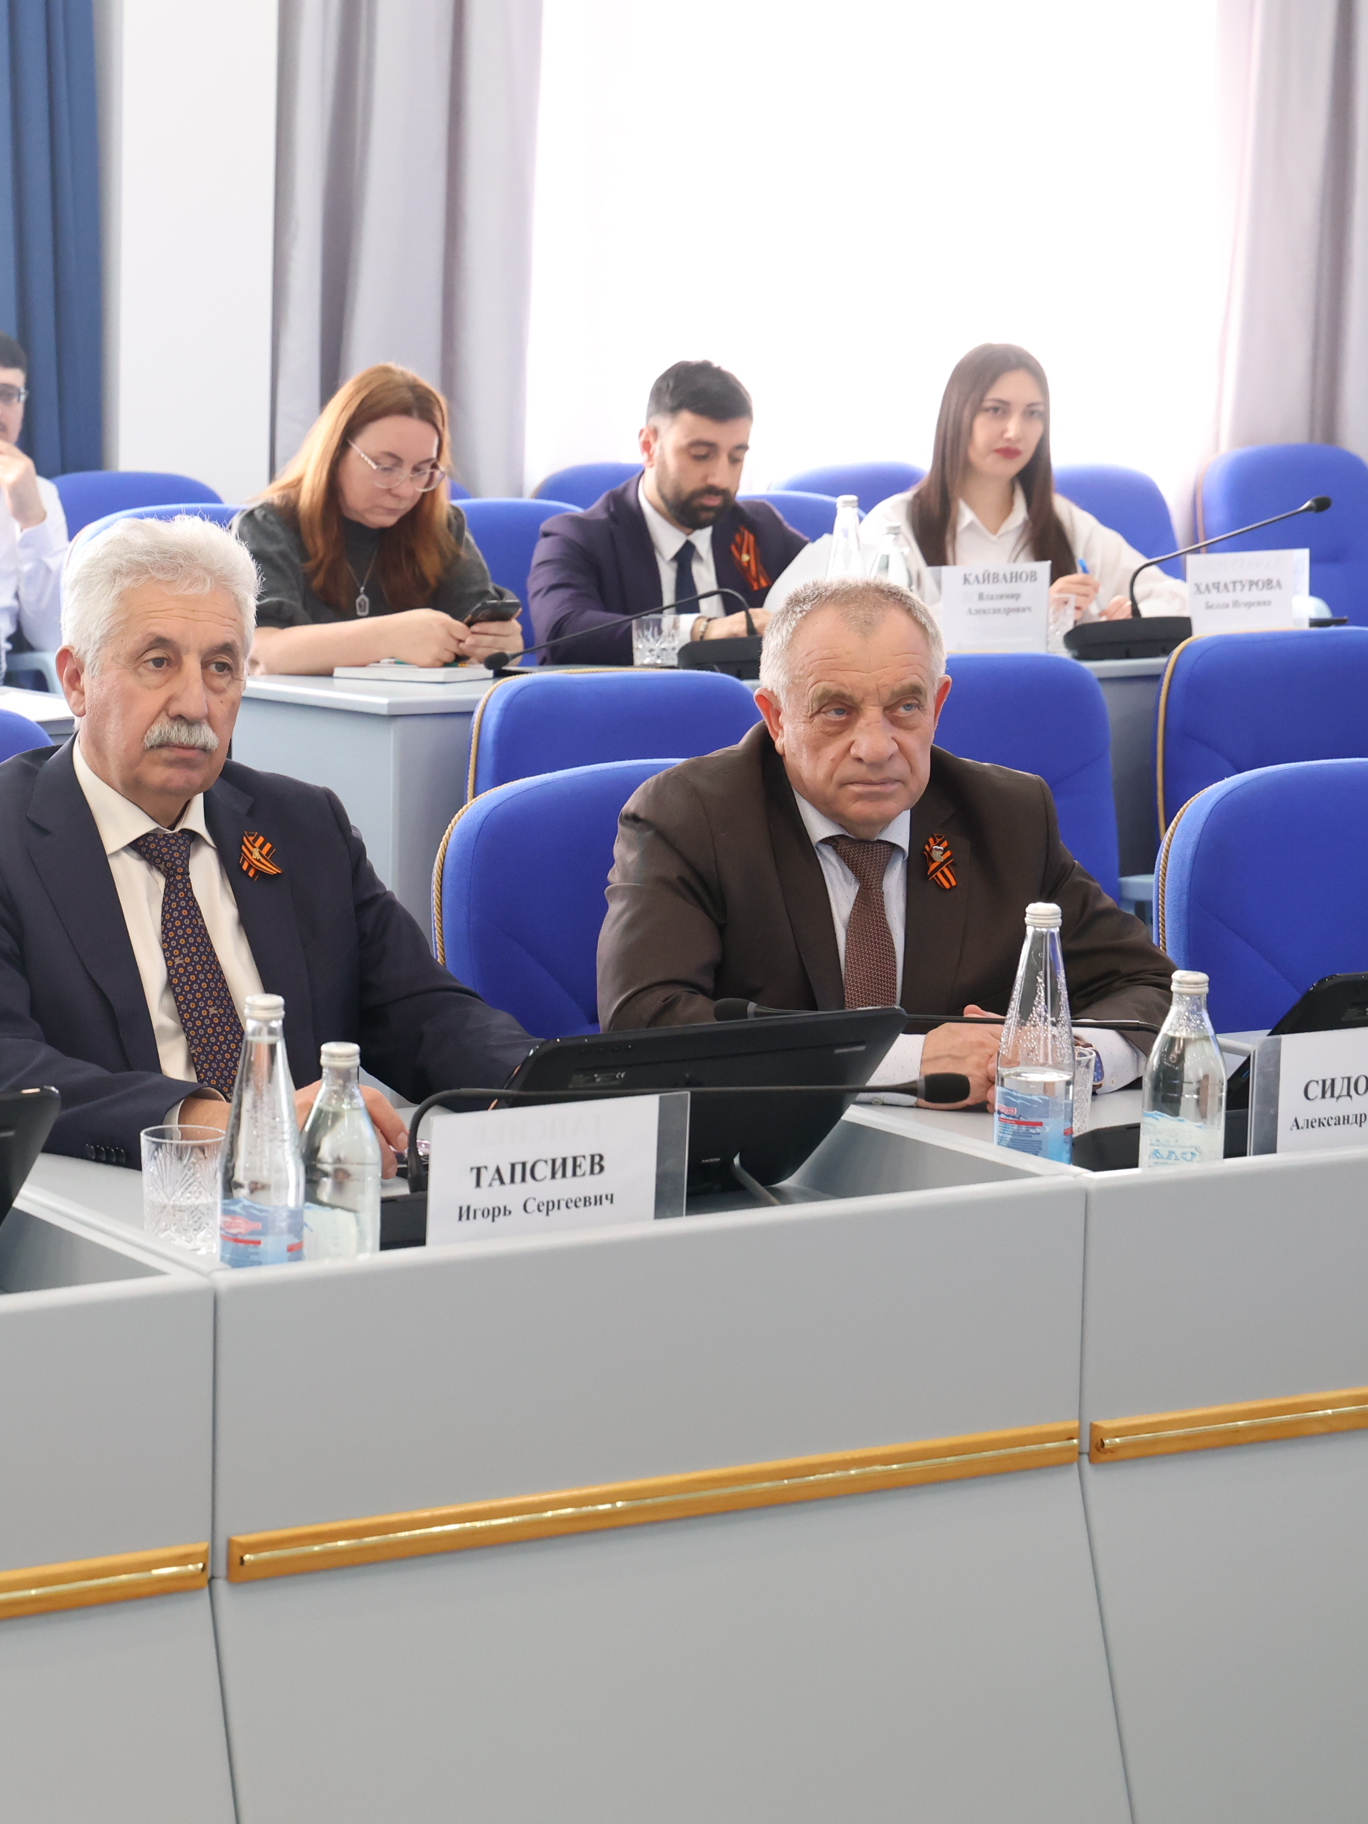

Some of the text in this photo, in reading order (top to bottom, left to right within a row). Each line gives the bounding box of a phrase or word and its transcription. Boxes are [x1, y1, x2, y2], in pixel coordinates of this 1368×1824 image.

[962, 569, 1038, 586] КАЙВАНОВ
[1194, 578, 1283, 596] ХАЧАТУРОВА
[1303, 1074, 1368, 1102] СИДО
[1290, 1112, 1368, 1131] Александр
[470, 1153, 606, 1189] ТАПСИЕВ
[457, 1193, 615, 1222] Игорь Сергеевич
